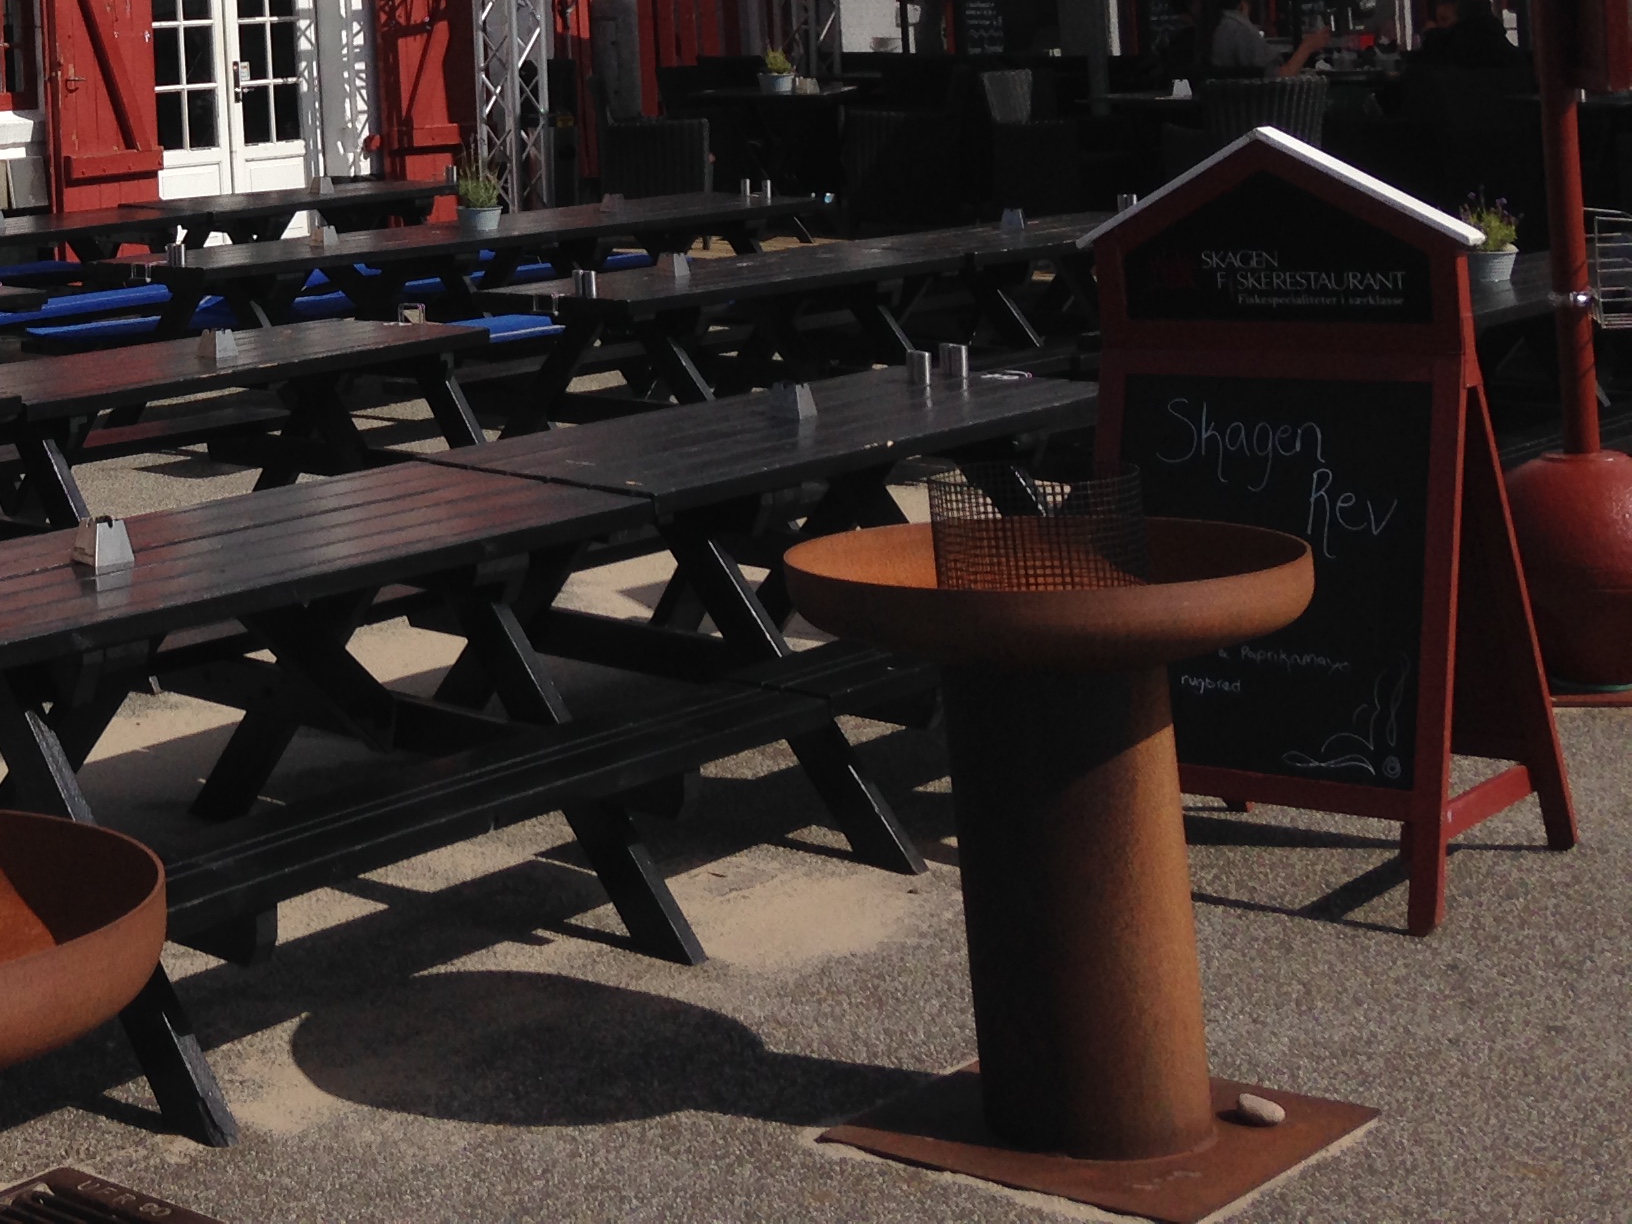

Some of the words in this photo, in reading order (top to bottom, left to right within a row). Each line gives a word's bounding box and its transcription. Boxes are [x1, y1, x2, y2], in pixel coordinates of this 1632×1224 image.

[1201, 249, 1279, 269] SKAGEN
[1216, 270, 1407, 293] FISKERESTAURANT
[1156, 398, 1326, 492] Skagen
[1307, 468, 1398, 558] Rev
